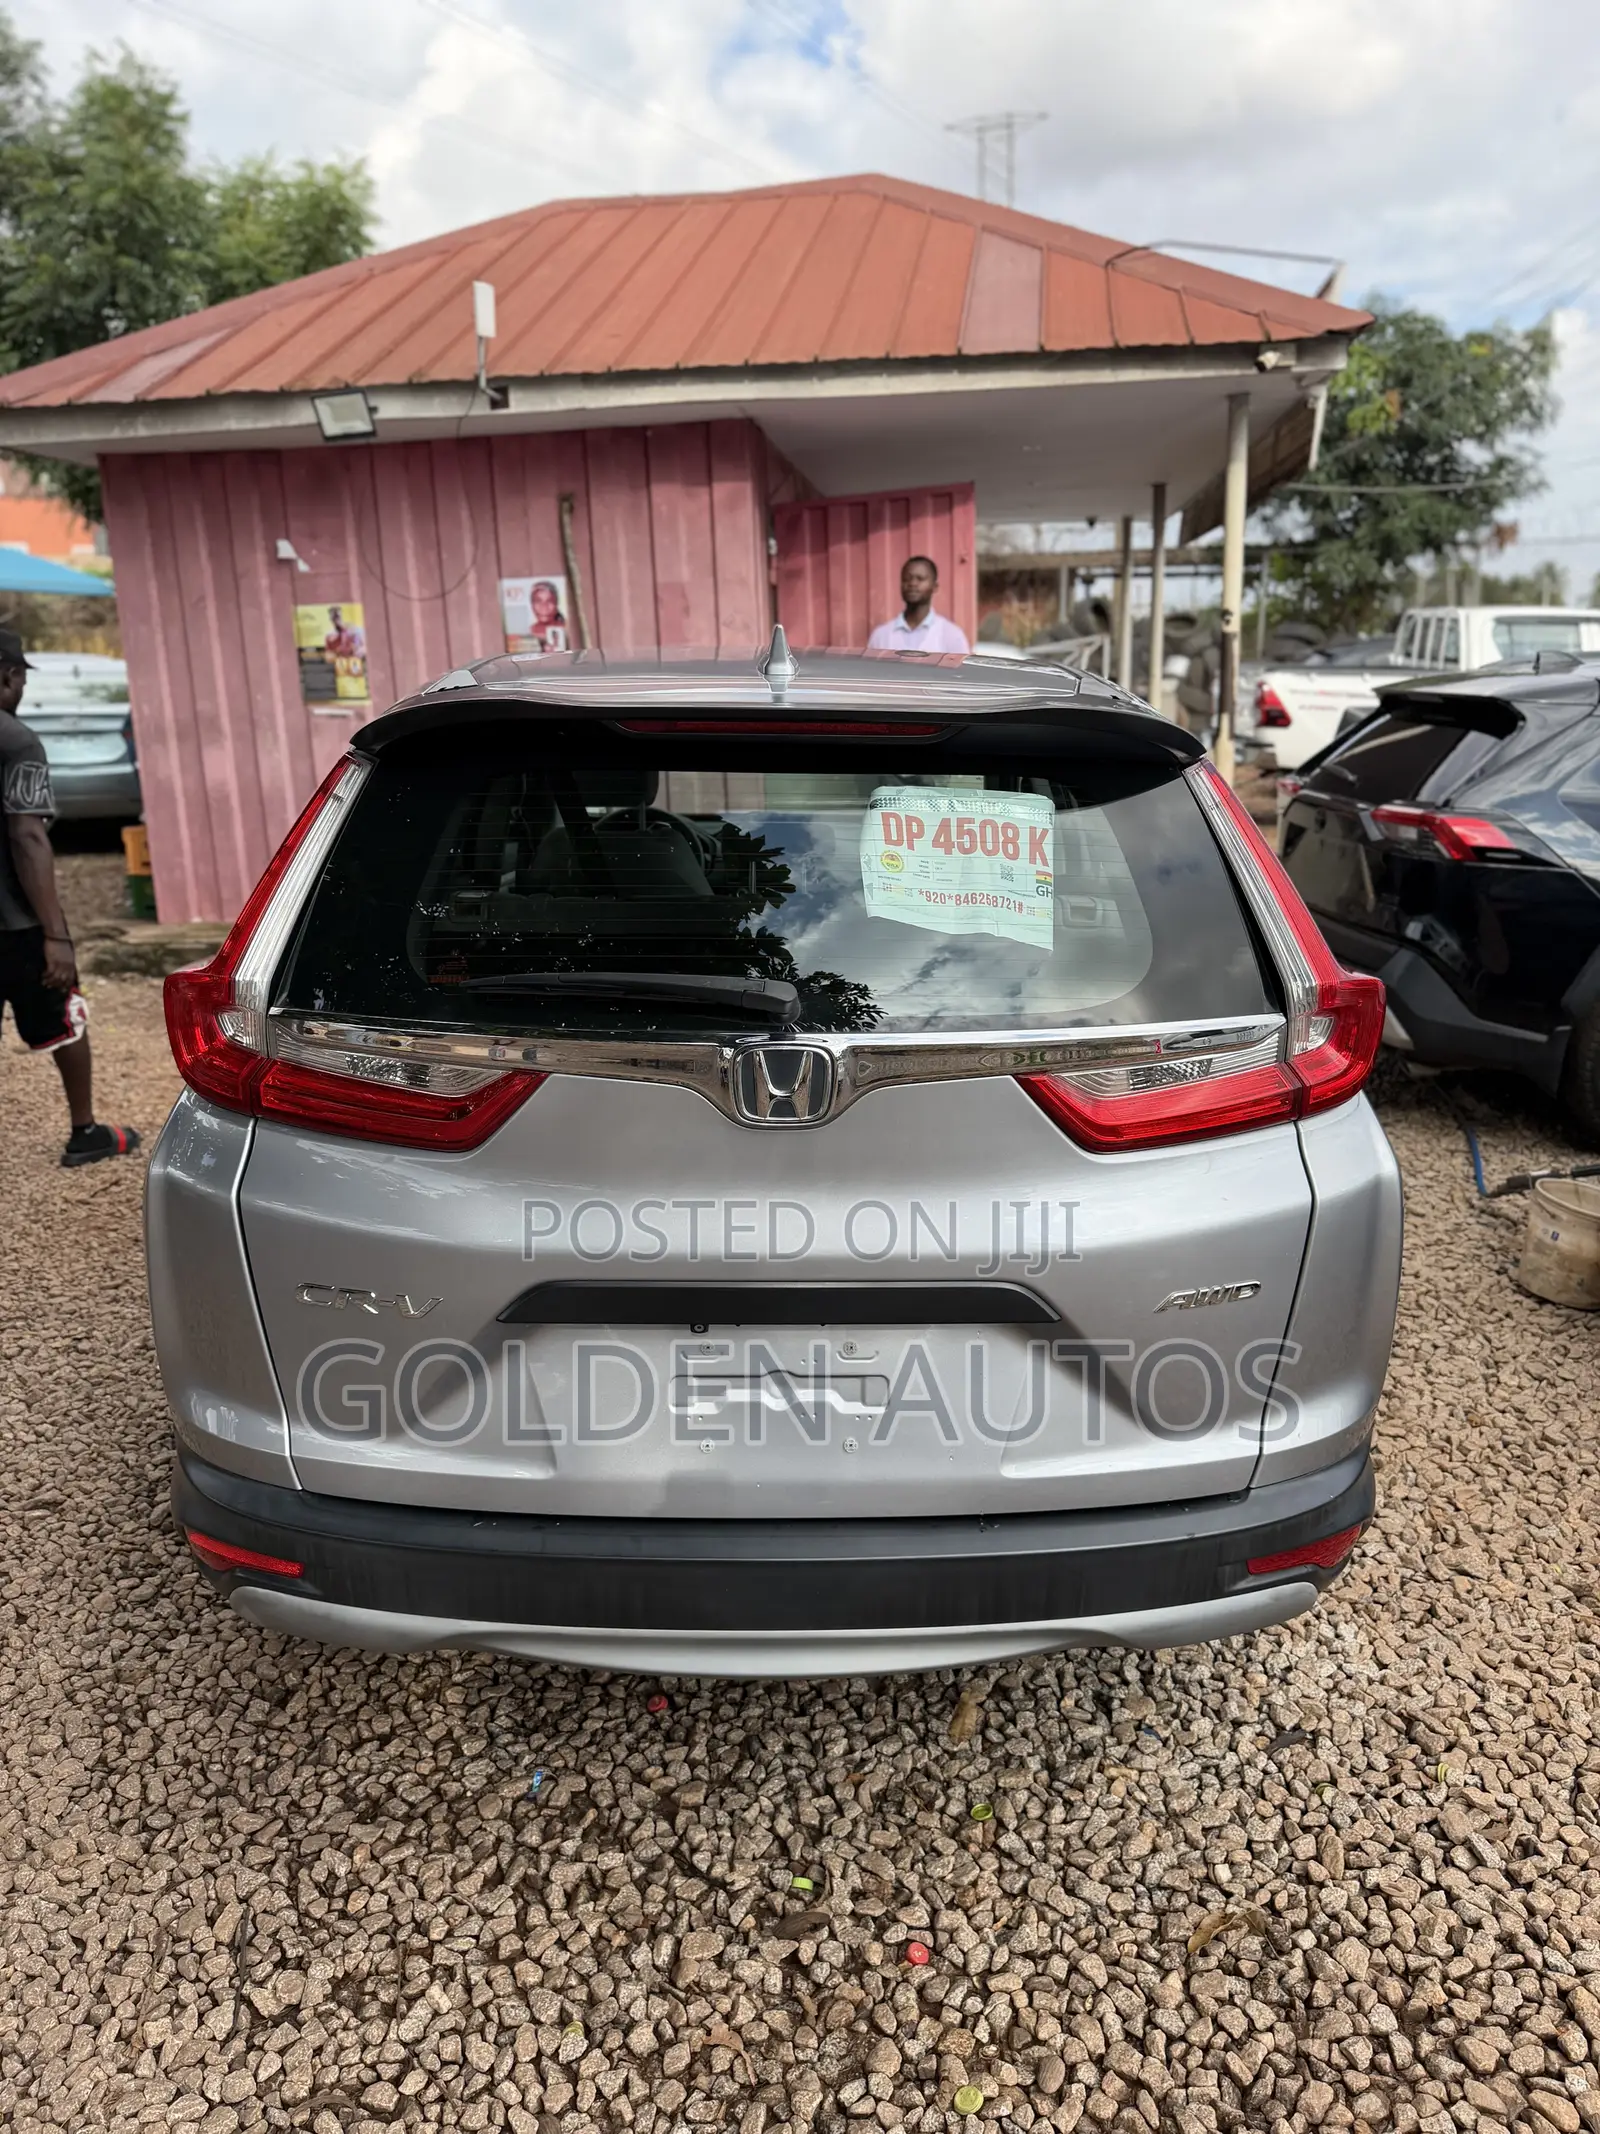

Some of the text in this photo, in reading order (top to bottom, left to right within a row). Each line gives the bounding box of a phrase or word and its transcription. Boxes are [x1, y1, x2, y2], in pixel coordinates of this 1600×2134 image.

[880, 811, 1050, 867] DP 4508 K
[296, 1280, 443, 1319] CR-V
[1153, 1279, 1262, 1314] AWD
